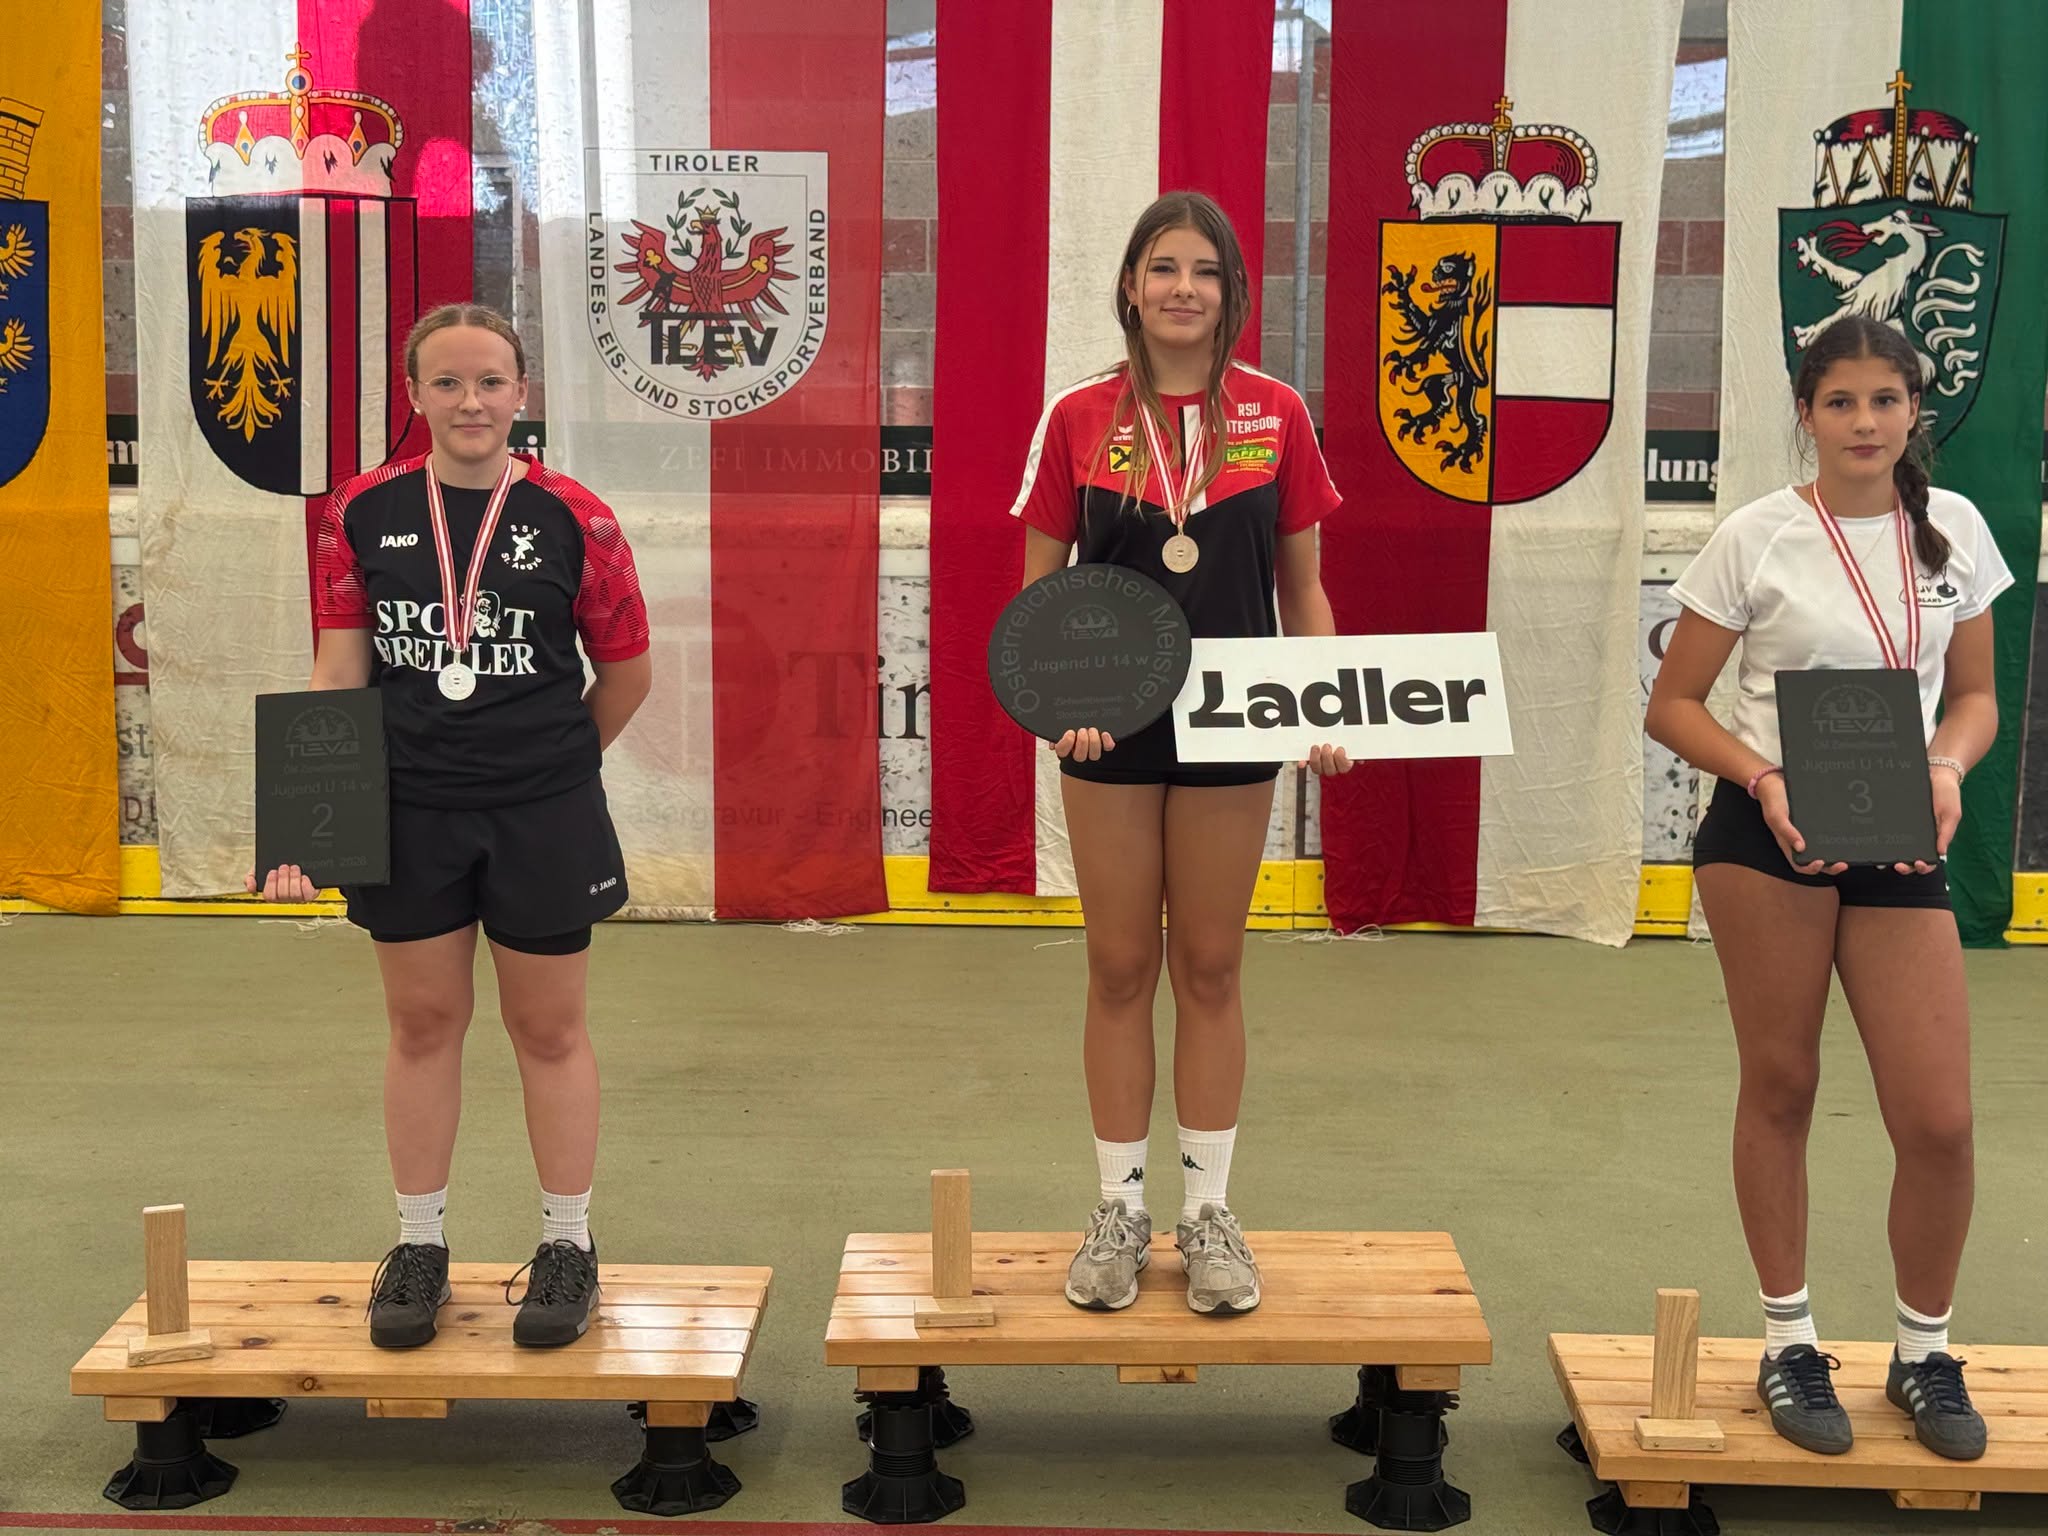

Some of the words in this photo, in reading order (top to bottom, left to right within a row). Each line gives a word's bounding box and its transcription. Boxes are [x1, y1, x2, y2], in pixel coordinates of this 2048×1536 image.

[650, 154, 759, 173] TIROLER
[588, 212, 608, 325] LANDES-
[687, 208, 827, 417] STOCKSPORTVERBAND
[597, 332, 630, 376] EIS-
[639, 312, 779, 366] TLEV
[634, 374, 679, 410] UND
[1237, 402, 1261, 417] RSU
[379, 533, 419, 549] JAKO
[374, 635, 538, 677] BREILER
[999, 568, 1155, 716] Österreichischer
[1132, 603, 1181, 711] Meister
[1028, 657, 1090, 675] Jugend
[1094, 655, 1106, 668] U
[1112, 654, 1131, 668] 14
[1135, 655, 1150, 667] w
[1189, 668, 1487, 730] Ladler
[1801, 759, 1855, 774] Jugend
[1860, 758, 1872, 770] U
[1877, 757, 1895, 770] 14
[1898, 759, 1913, 770] w
[271, 779, 320, 799] Jugend
[325, 779, 336, 794] U
[341, 779, 356, 792] 14
[1847, 778, 1874, 815] 3
[311, 801, 335, 839] 2
[599, 877, 618, 892] JAKO
